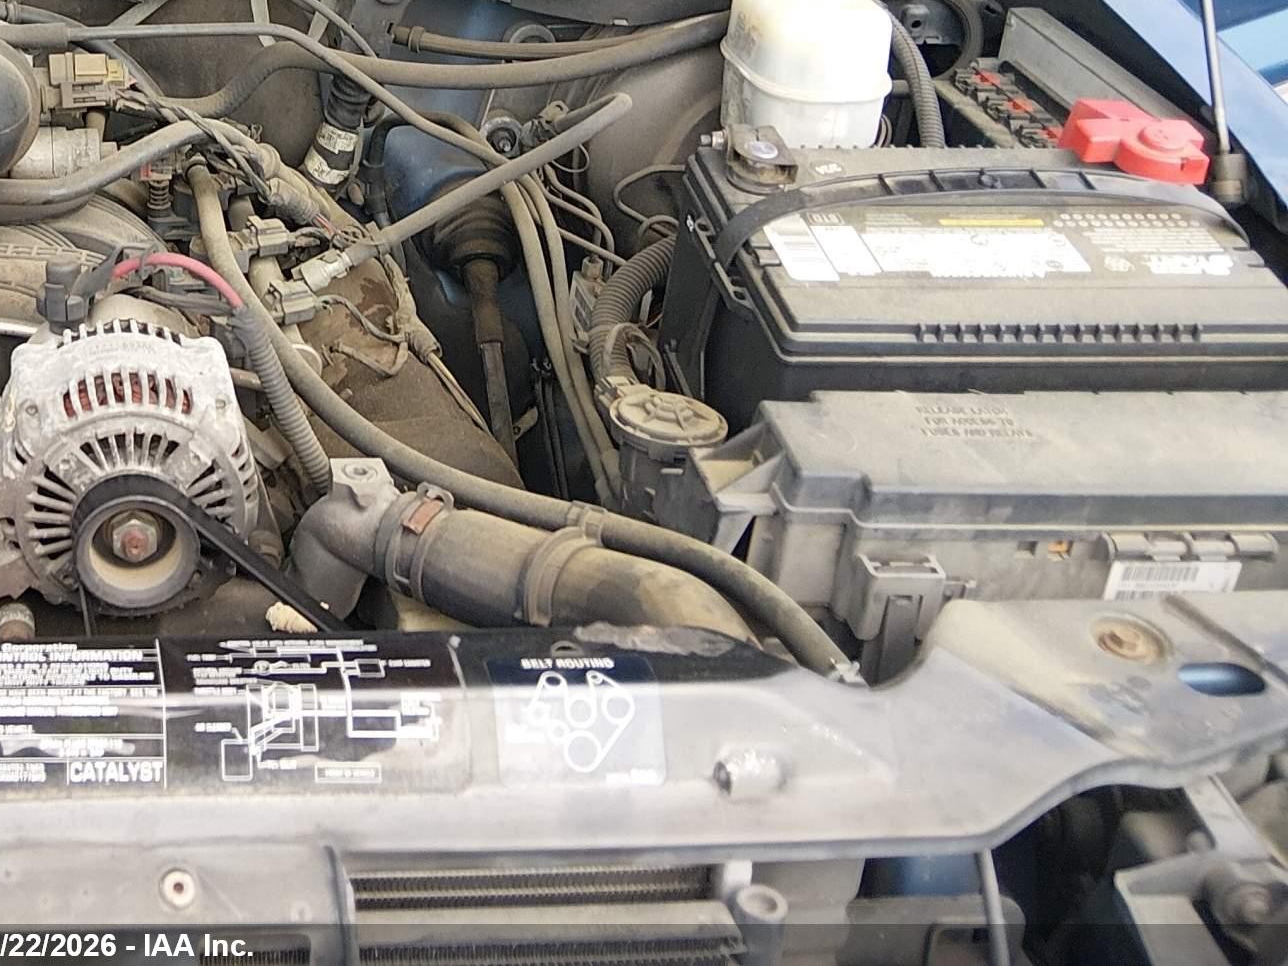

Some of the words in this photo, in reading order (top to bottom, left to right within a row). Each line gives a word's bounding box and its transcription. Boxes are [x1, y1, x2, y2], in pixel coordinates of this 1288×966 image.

[1, 642, 78, 653] Corporation
[49, 650, 144, 662] INFORMATION
[521, 658, 553, 670] BELT
[556, 657, 615, 669] ROUTING
[70, 761, 163, 783] CATALYST
